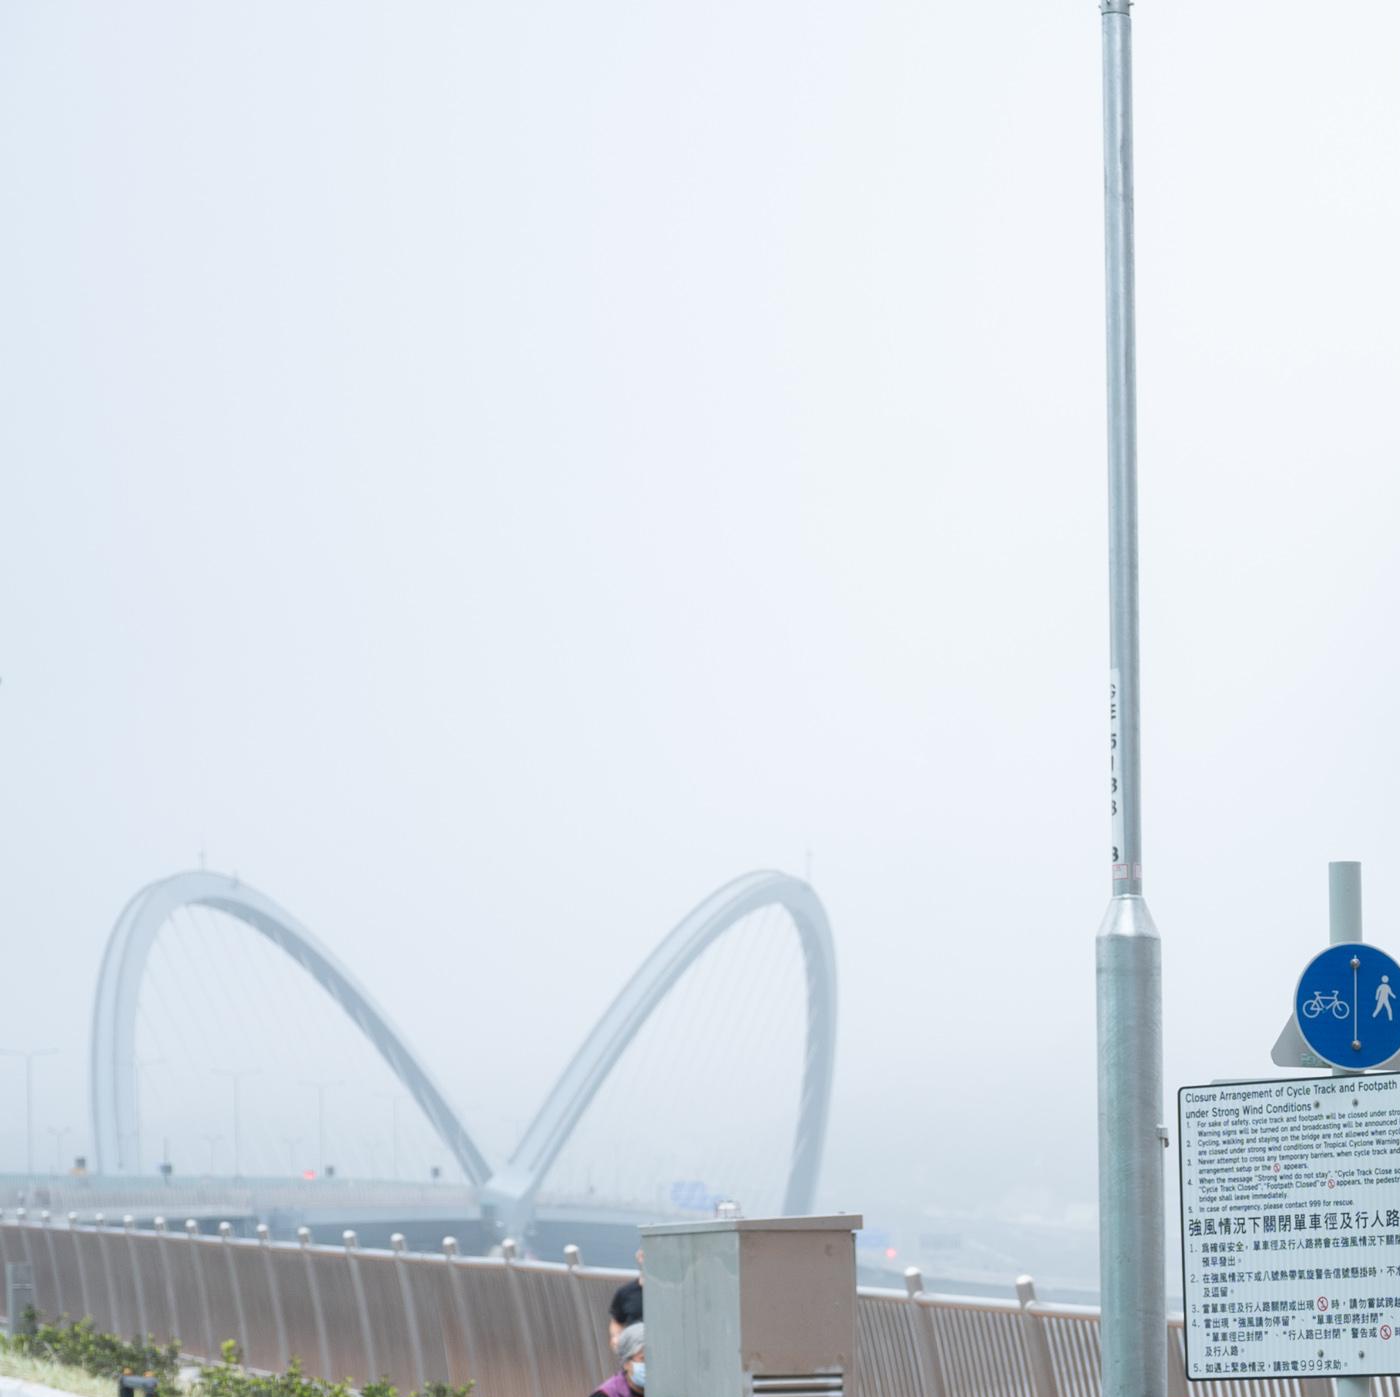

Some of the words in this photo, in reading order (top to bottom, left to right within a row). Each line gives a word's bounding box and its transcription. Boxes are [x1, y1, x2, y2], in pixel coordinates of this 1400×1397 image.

[1185, 1092, 1218, 1104] Closure
[1220, 1089, 1273, 1103] Arrangement
[1275, 1088, 1284, 1098] of
[1287, 1086, 1311, 1099] Cycle
[1313, 1084, 1336, 1095] Track
[1339, 1083, 1355, 1094] and
[1358, 1080, 1398, 1094] Footpath
[1186, 1109, 1208, 1119] under
[1212, 1107, 1240, 1119] Strong
[1243, 1105, 1263, 1115] Wind
[1266, 1102, 1312, 1114] Conditions
[1252, 1118, 1268, 1127] cycle
[1299, 1114, 1323, 1124] footpath
[1326, 1113, 1336, 1121] will
[1348, 1111, 1368, 1119] closed
[1370, 1110, 1387, 1118] under
[1198, 1130, 1221, 1139] Warning
[1222, 1129, 1237, 1138] signs
[1260, 1126, 1279, 1134] turned
[1302, 1123, 1341, 1133] broadcasting
[1365, 1119, 1397, 1128] announced
[1222, 1138, 1244, 1147] walking
[1258, 1136, 1279, 1145] staying
[1301, 1133, 1320, 1142] bridge
[1345, 1130, 1369, 1138] allowed
[1371, 1129, 1386, 1137] when
[1209, 1148, 1228, 1156] closed
[1230, 1147, 1246, 1155] under
[1248, 1146, 1266, 1155] strong
[1283, 1143, 1314, 1151] conditions
[1324, 1141, 1347, 1151] Tropical
[1349, 1140, 1374, 1149] Cyclone
[1376, 1138, 1400, 1148] Warning
[1198, 1158, 1215, 1166] Never
[1217, 1157, 1240, 1166] attempt
[1279, 1153, 1309, 1163] temporary
[1337, 1150, 1352, 1158] when
[1354, 1149, 1370, 1158] cycle
[1372, 1148, 1387, 1156] track
[1198, 1167, 1234, 1177] arrangement
[1236, 1166, 1252, 1174] setup
[1199, 1177, 1215, 1185] When
[1228, 1177, 1253, 1185] message
[1220, 1185, 1235, 1193] Track
[1199, 1196, 1217, 1204] bridge
[1264, 1203, 1284, 1212] please
